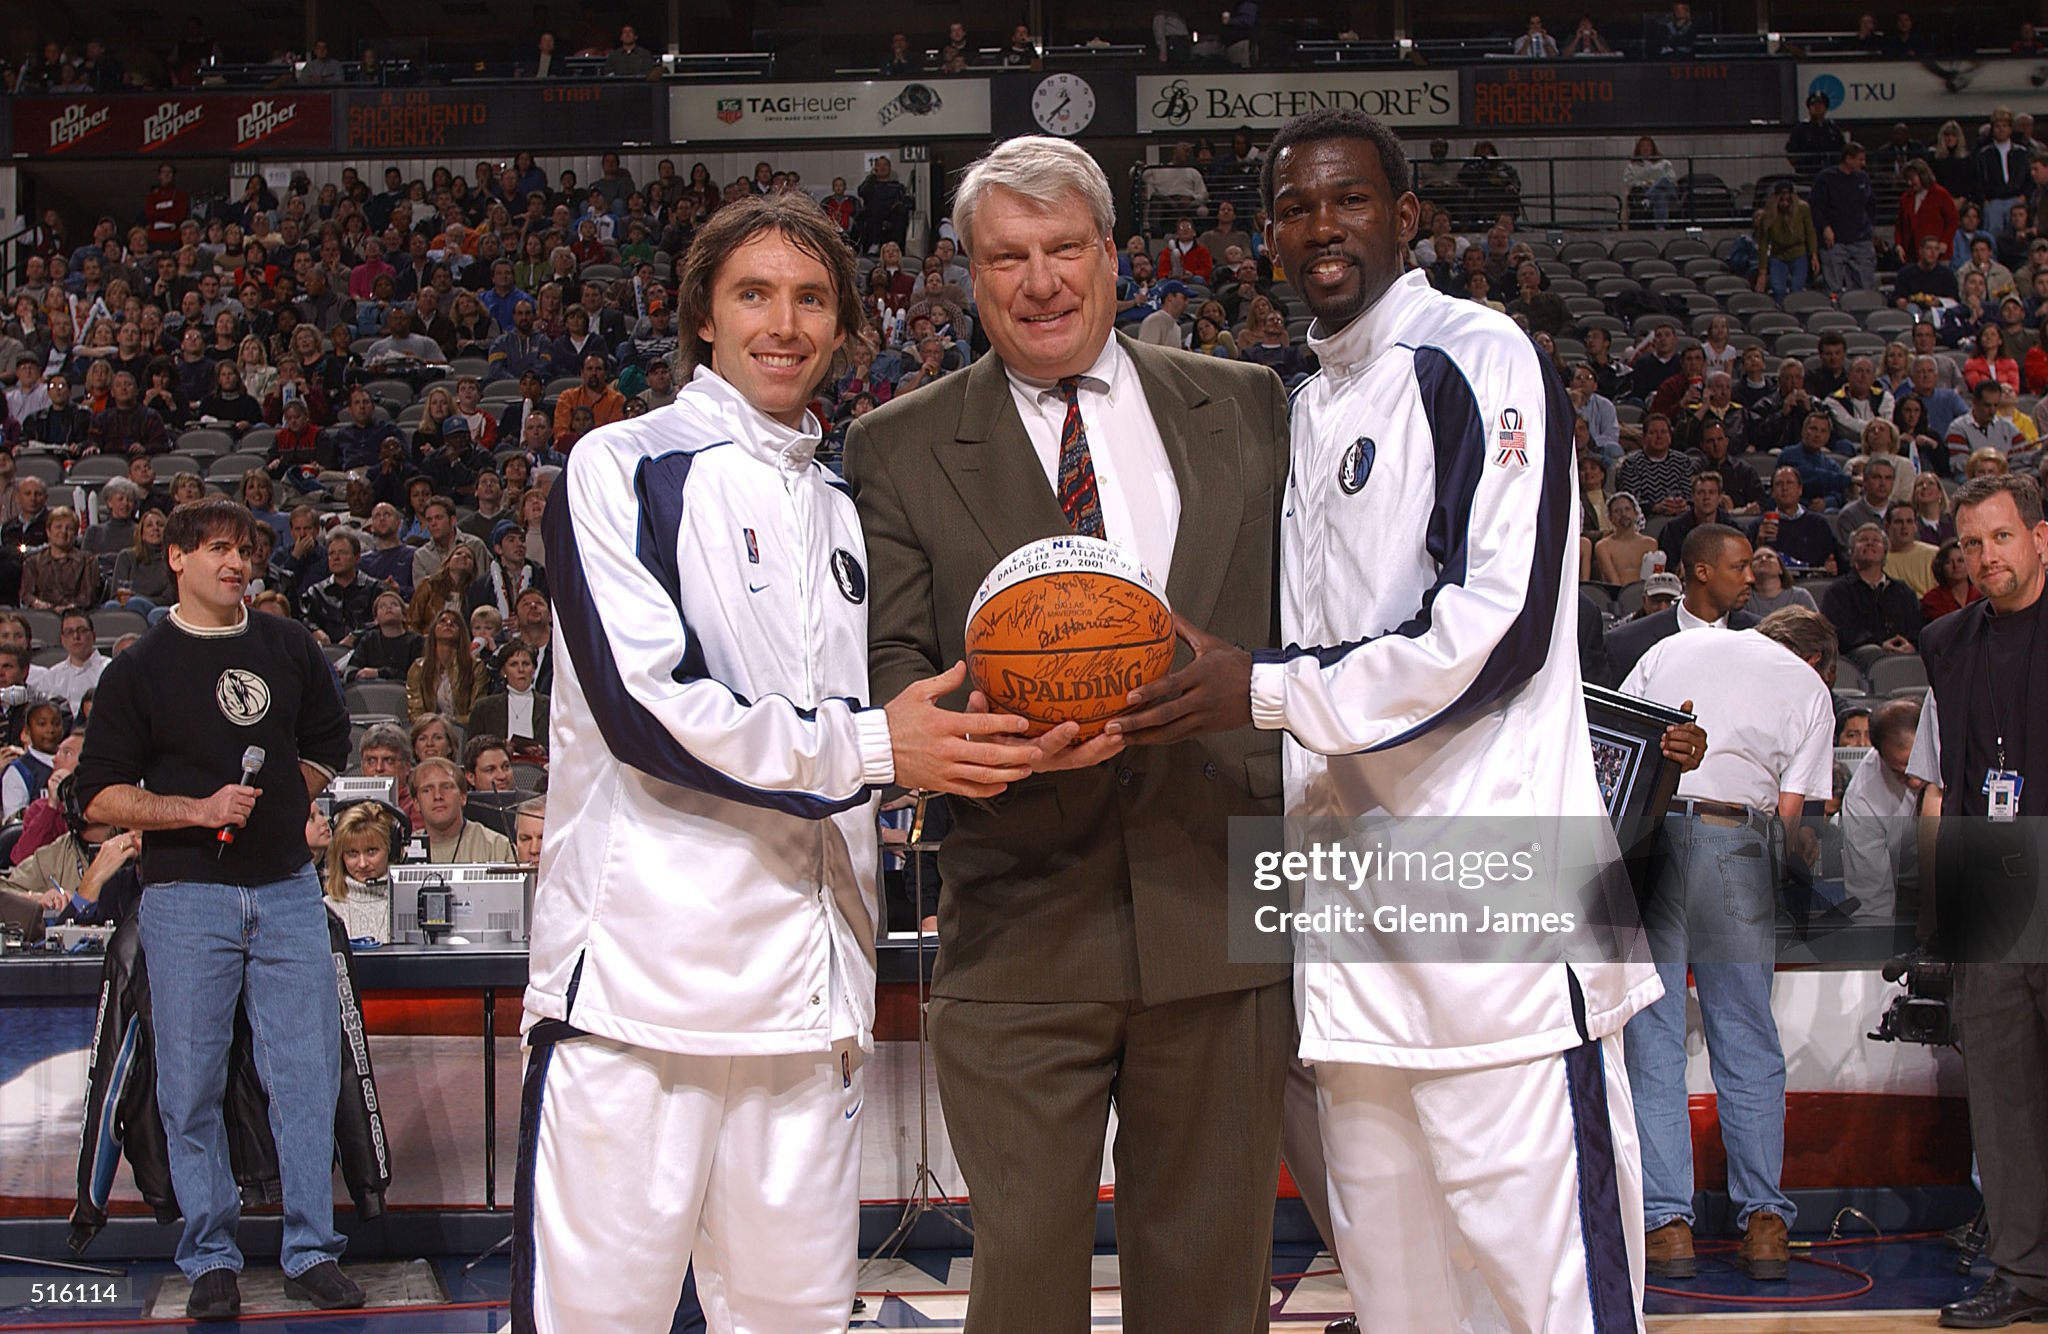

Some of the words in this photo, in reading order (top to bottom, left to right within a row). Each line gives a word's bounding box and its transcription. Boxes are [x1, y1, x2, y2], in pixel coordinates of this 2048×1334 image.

[1669, 64, 1729, 80] START
[543, 87, 602, 102] START
[1205, 81, 1450, 119] BACHENDORF'S
[1475, 81, 1613, 104] SACRAMENTO
[1850, 83, 1896, 101] TXU
[64, 103, 88, 124] Dr
[158, 101, 181, 123] Dr
[251, 100, 274, 122] Dr
[348, 102, 487, 129] SACRAMENTO
[1475, 102, 1574, 125] PHOENIX
[50, 105, 110, 147] Pepper
[143, 104, 203, 146] Pepper
[237, 103, 297, 144] Pepper
[348, 125, 446, 147] PHOENIX
[1052, 539, 1120, 557] NELSON
[997, 557, 1032, 581] DALLAS
[1036, 552, 1050, 562] 113
[1070, 548, 1117, 565] ATLANTA
[1028, 562, 1051, 574] DEC.
[1056, 559, 1073, 569] 29,
[1078, 558, 1104, 570] 2001
[1047, 609, 1093, 618] MAVERICKS
[1054, 601, 1085, 610] DALLAS
[1001, 660, 1143, 702] SPALDING
[333, 952, 370, 1076] DECEMBER
[362, 1078, 377, 1112] 29
[370, 1113, 389, 1180] 2001
